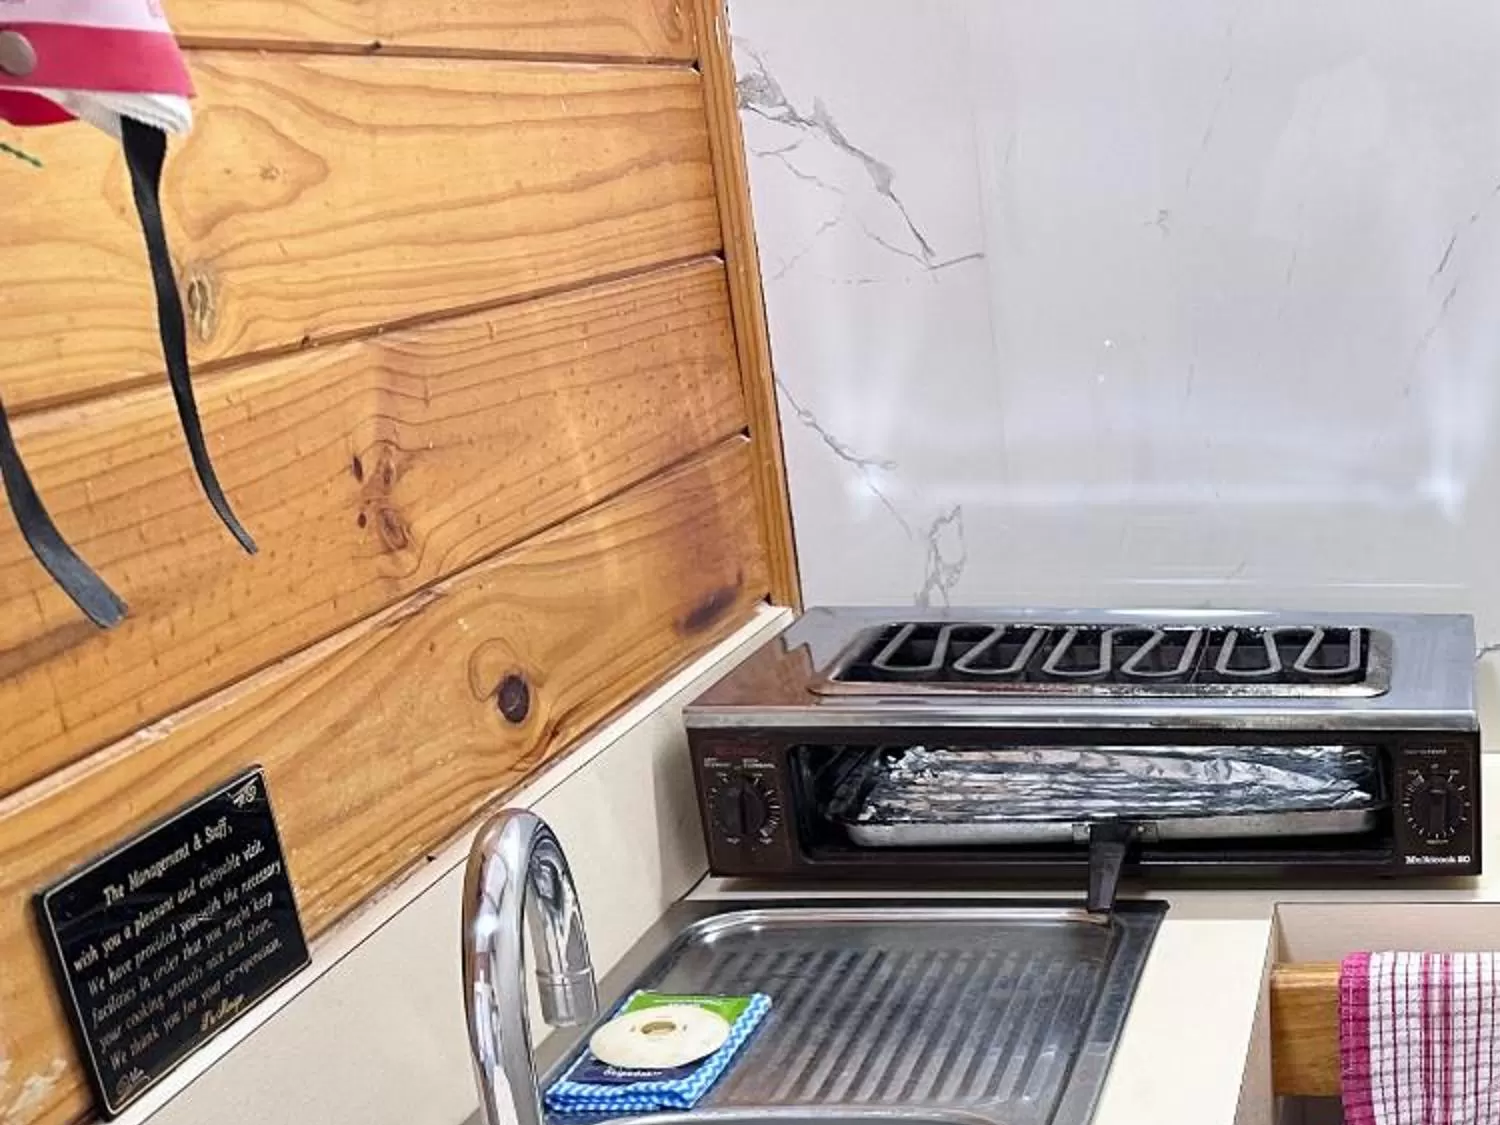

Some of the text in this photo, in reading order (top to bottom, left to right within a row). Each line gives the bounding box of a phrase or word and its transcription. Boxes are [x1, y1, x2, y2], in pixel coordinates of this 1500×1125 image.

[102, 884, 125, 907] The
[128, 842, 190, 892] Management
[193, 832, 203, 851] &
[73, 943, 99, 972] wish
[102, 933, 122, 959] you
[123, 925, 133, 940] a
[134, 896, 175, 937] pleasant
[177, 878, 197, 905] and
[88, 976, 106, 997] We
[108, 959, 133, 986] have
[135, 922, 177, 969] provided
[223, 887, 239, 905] the
[241, 860, 282, 894] necessary
